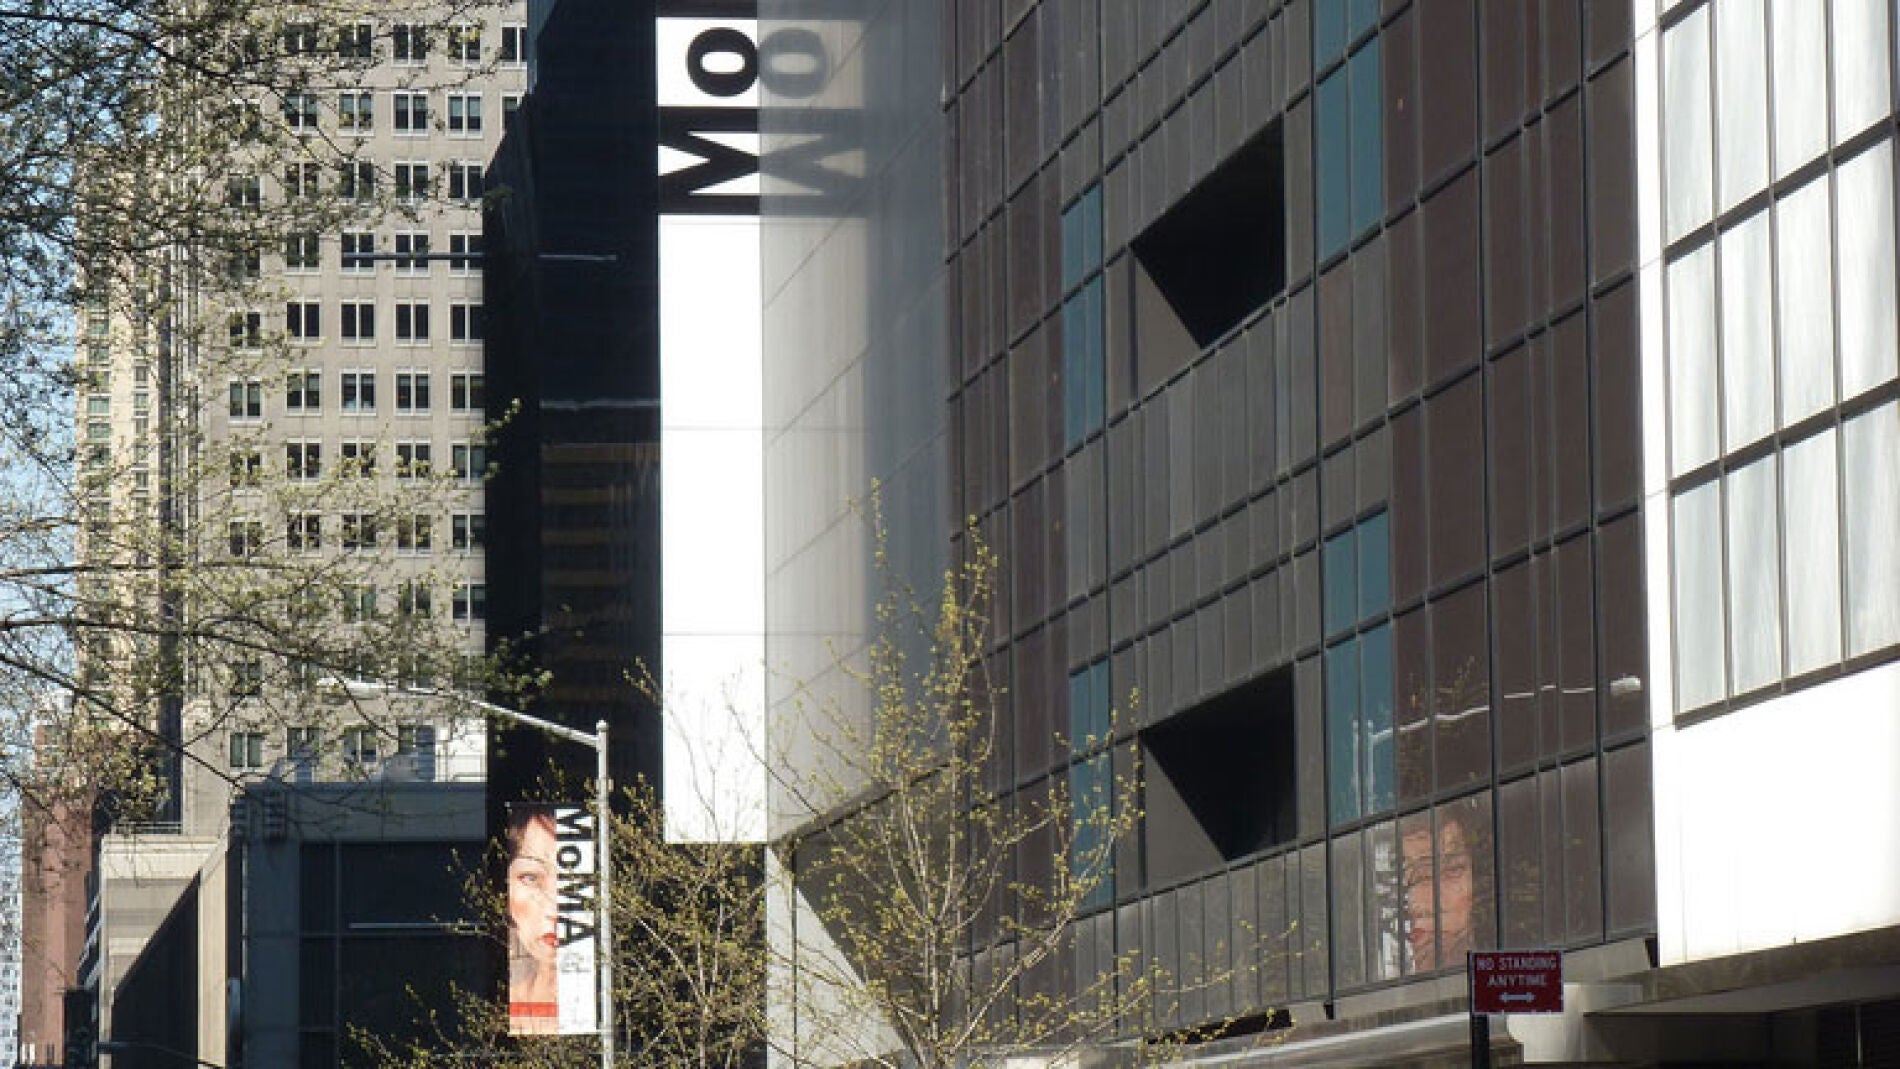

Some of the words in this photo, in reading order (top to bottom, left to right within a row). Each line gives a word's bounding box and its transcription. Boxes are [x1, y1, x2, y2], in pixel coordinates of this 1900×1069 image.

[655, 0, 758, 215] Mo
[554, 805, 594, 947] MoMA
[1477, 957, 1494, 970] NO
[1499, 957, 1557, 970] STANDING
[1487, 974, 1545, 987] ANYTIME
